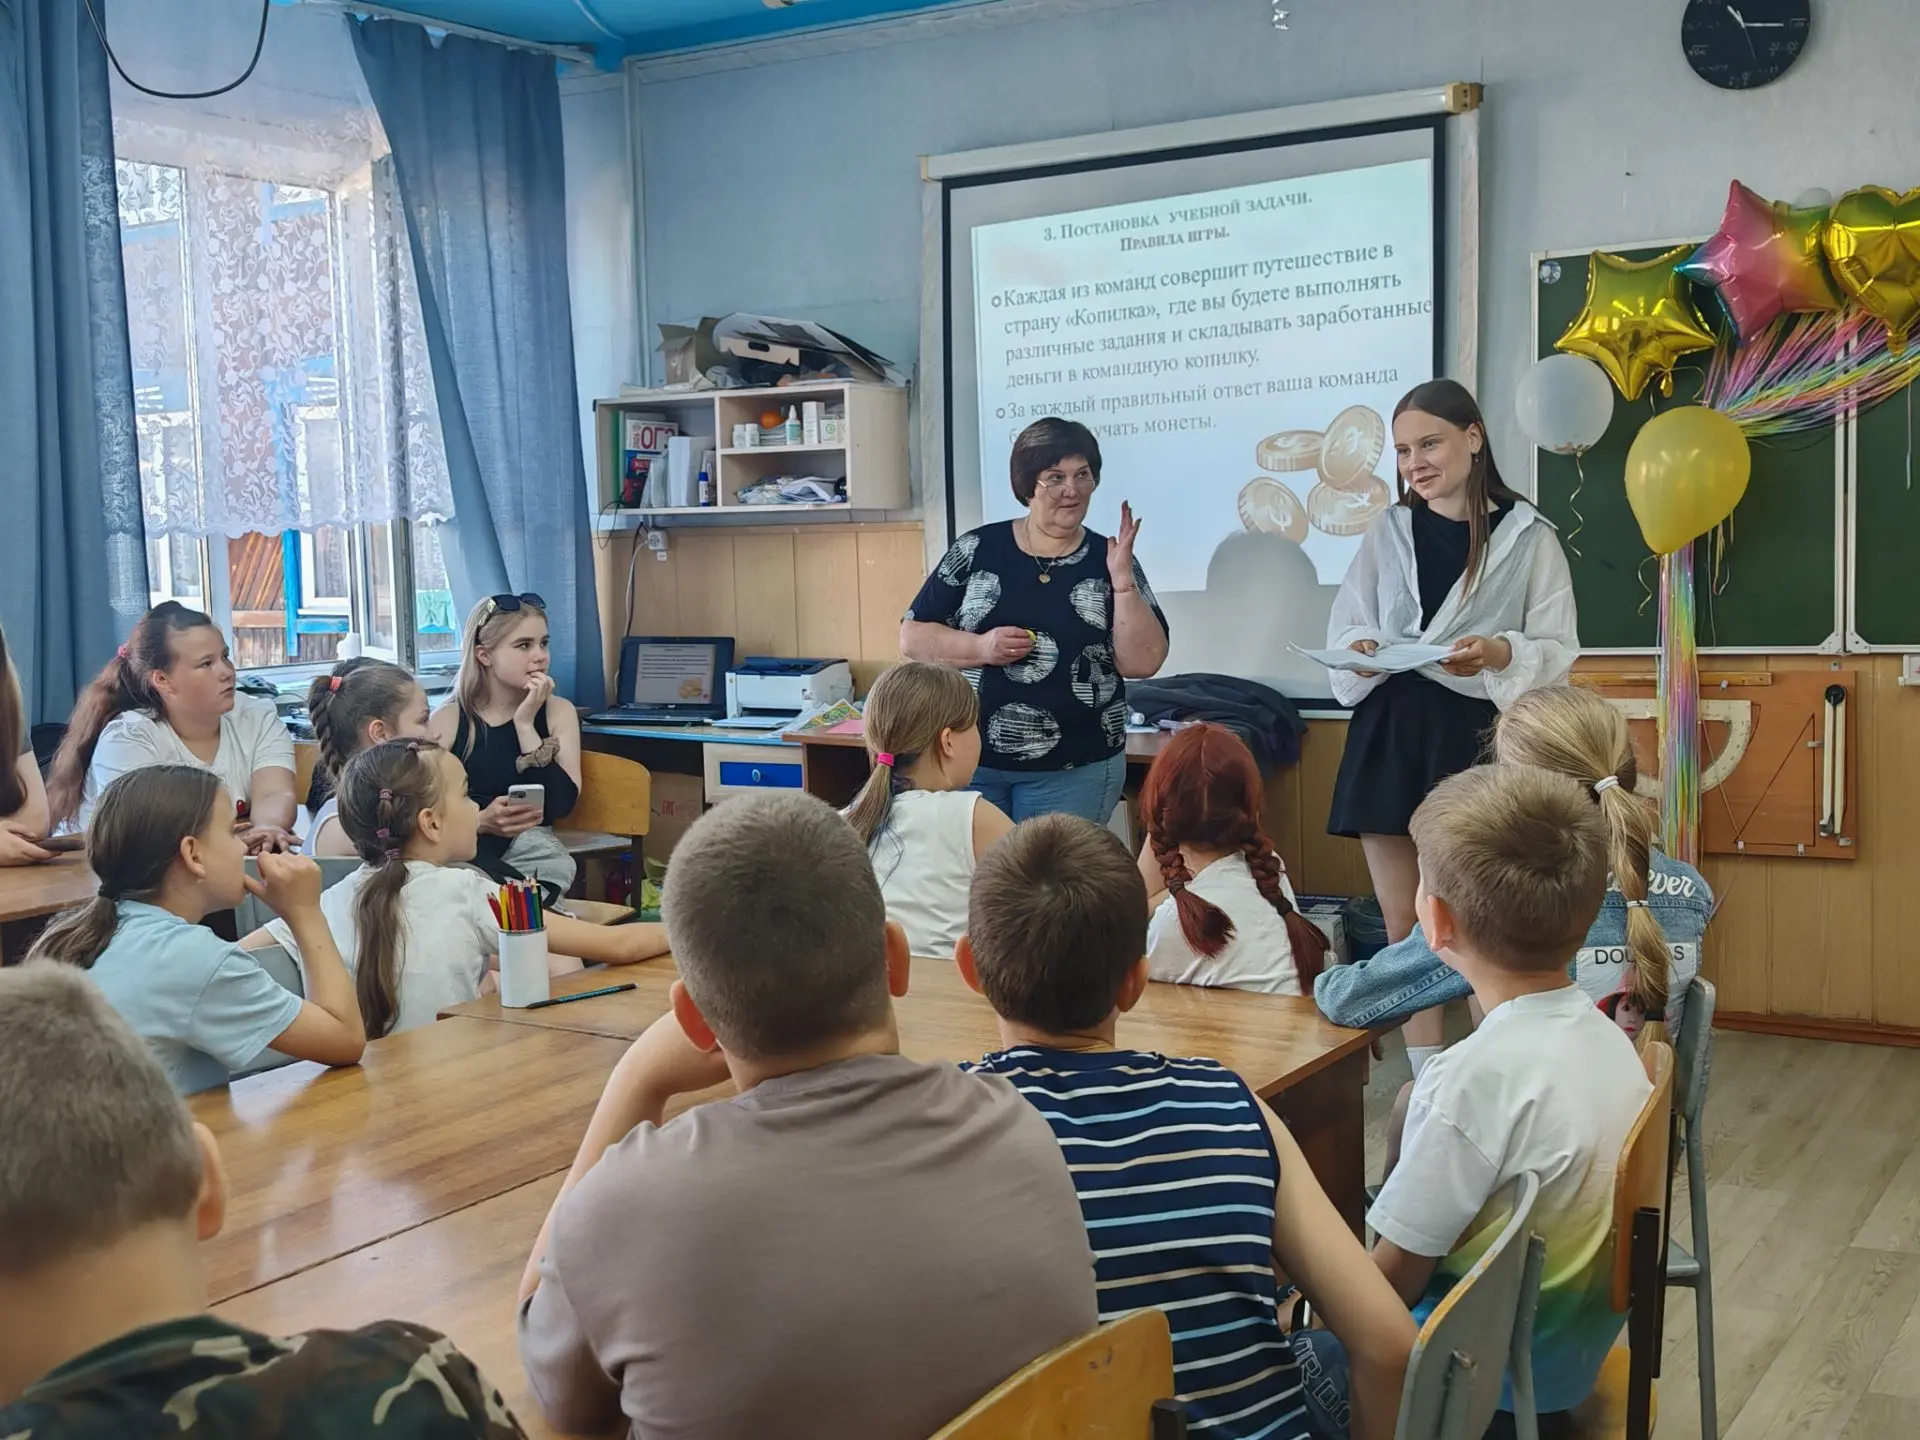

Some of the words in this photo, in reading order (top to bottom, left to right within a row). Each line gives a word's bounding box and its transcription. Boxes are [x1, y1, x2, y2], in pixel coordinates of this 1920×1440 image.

[1044, 227, 1057, 242] 3.
[1004, 286, 1066, 307] Каждая
[1071, 284, 1090, 300] из
[1095, 274, 1156, 296] команд
[1160, 263, 1248, 288] совершит
[1253, 245, 1378, 280] путешествие
[1383, 244, 1394, 259] в
[1004, 314, 1061, 338] страну
[1065, 302, 1161, 329] «Копилка»,
[1168, 298, 1197, 317] где
[1202, 295, 1226, 312] вы
[1231, 286, 1290, 312] будете
[1295, 273, 1402, 300] выполнять
[1005, 338, 1095, 366] различные
[1099, 329, 1166, 352] задания
[1172, 329, 1182, 344] и
[1188, 315, 1292, 342] складывать
[1297, 298, 1433, 332] заработанные
[1005, 369, 1062, 390] деньги
[1068, 368, 1078, 383] в
[1082, 356, 1179, 381] командную
[1184, 349, 1260, 371] копилку.
[1007, 401, 1026, 420] За
[1030, 394, 1096, 418] каждый
[1101, 382, 1208, 414] правильный
[1213, 381, 1263, 402] ответ
[1267, 374, 1313, 394] ваша
[1318, 366, 1399, 388] команда
[1093, 419, 1139, 440] учать
[1143, 413, 1217, 434] монеты.
